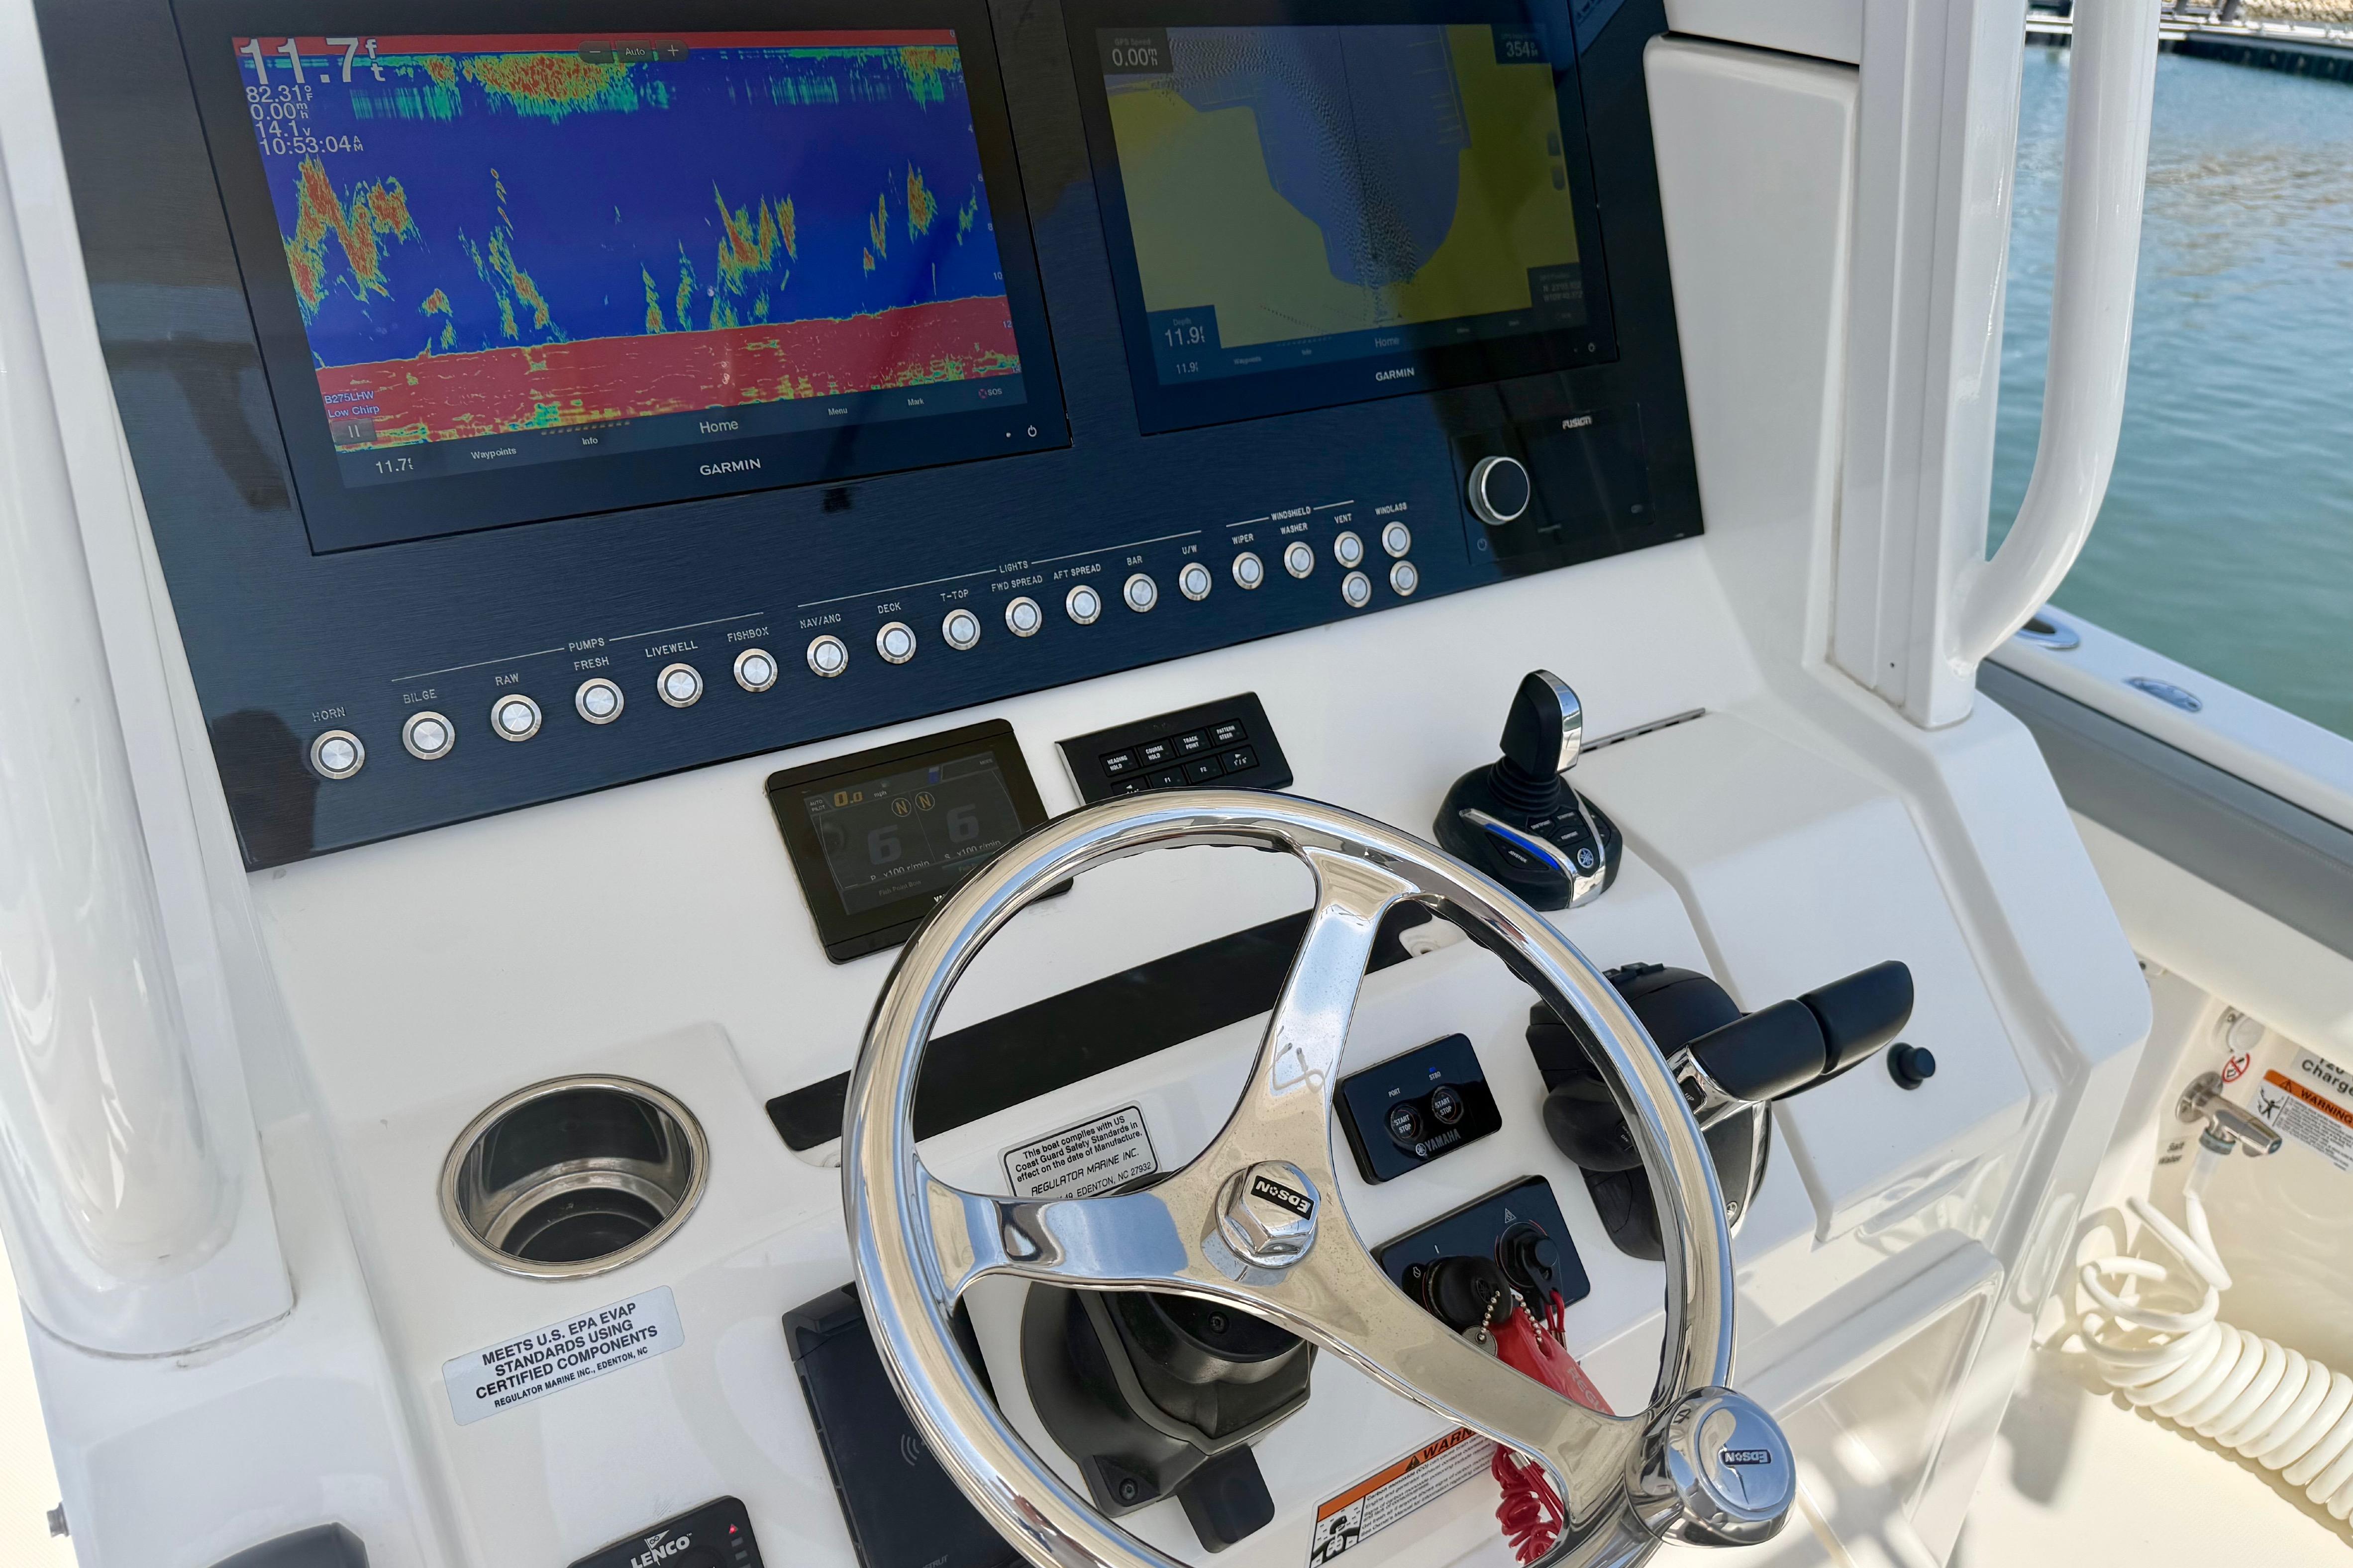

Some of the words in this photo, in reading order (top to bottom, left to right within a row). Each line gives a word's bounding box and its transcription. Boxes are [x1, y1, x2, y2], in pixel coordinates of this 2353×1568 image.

[625, 47, 645, 56] Auto
[1506, 41, 1530, 58] 354
[240, 37, 359, 85] 11.7
[1112, 48, 1148, 67] 0.00
[959, 75, 964, 83] 2
[246, 85, 302, 102] 82.31
[250, 102, 296, 120] 0.00
[255, 120, 299, 138] 14.1
[968, 124, 973, 133] 4
[260, 135, 351, 155] 10:53:04
[994, 272, 1003, 280] 10
[1003, 320, 1012, 328] 12
[1165, 326, 1200, 347] 11.9
[1375, 337, 1400, 348] Home
[1176, 362, 1195, 374] 11.9
[1375, 367, 1414, 382] GARMIN
[324, 390, 375, 405] B275LHW
[987, 388, 1003, 396] SOS
[908, 397, 924, 406] Mark
[327, 407, 349, 418] Low
[352, 404, 381, 418] Chirp
[828, 406, 848, 416] Menu
[700, 418, 738, 434] Home
[582, 436, 598, 446] Info
[471, 446, 517, 460] Waypoints
[375, 458, 407, 475] 11.7
[700, 458, 761, 476] GARMIN
[1271, 506, 1312, 521] WINDSHIELD
[1375, 502, 1408, 516] WINDLASS
[1334, 513, 1352, 524] VENT
[1280, 522, 1308, 535] WASHER
[1231, 533, 1254, 545] WIPER
[1182, 544, 1198, 555] U/W
[999, 561, 1028, 574] LIGHTS
[1126, 555, 1143, 566] BAR
[1053, 570, 1069, 581] AFT
[1071, 563, 1102, 577] SPREAD
[991, 582, 1009, 593] FWD
[1011, 575, 1043, 589] SPREAD
[940, 589, 969, 602] T-TOP
[877, 602, 902, 614] DECK
[800, 613, 841, 629] NAV/ANC
[727, 626, 769, 643] FISHBOX
[568, 637, 605, 652] PUMPS
[645, 640, 699, 658] LIVEWELL
[573, 656, 610, 672] FRESH
[495, 673, 519, 686] RAW
[403, 689, 437, 704] BILGE
[312, 706, 346, 722] HORN
[1216, 725, 1236, 735] PATTERN
[1183, 735, 1199, 744] TRACK
[1145, 745, 1164, 755] COURSE
[1107, 755, 1128, 765] HEADING
[834, 791, 863, 807] 0.0
[874, 790, 887, 798] mph
[946, 803, 980, 843] 6
[867, 824, 902, 865] 6
[1388, 1087, 1401, 1097] PORT
[1434, 1097, 1450, 1108] START
[2301, 1087, 2353, 1125] WARNING
[1440, 1105, 1452, 1116] STOP
[1394, 1114, 1410, 1126] START
[1399, 1123, 1411, 1133] STOP
[1023, 1148, 1040, 1160] This
[1042, 1142, 1059, 1153] boat
[1061, 1128, 1095, 1147] complies
[1096, 1121, 1112, 1133] with
[1114, 1116, 1125, 1125] US
[1425, 1128, 1461, 1152] YAMAHA
[1016, 1160, 1038, 1173] Coast
[1040, 1150, 1064, 1164] Guard
[1066, 1141, 1089, 1157] Safety
[1091, 1125, 1128, 1144] Standards
[1130, 1121, 1138, 1130] in
[1017, 1170, 1039, 1182] effect
[1053, 1159, 1066, 1169] the
[1067, 1152, 1084, 1164] date
[1085, 1147, 1094, 1156] of
[1095, 1131, 1143, 1153] Manufacture.
[1032, 1169, 1084, 1197] REGULATOR
[1087, 1154, 1120, 1175] MARINE
[1123, 1148, 1139, 1161] INC.
[1077, 1177, 1116, 1197] EDENTON,
[1118, 1170, 1129, 1181] NC
[1130, 1162, 1152, 1176] 27932
[1256, 1180, 1311, 1213] EDSON
[482, 1339, 533, 1366] MEETS
[537, 1329, 566, 1346] U.S.
[568, 1317, 598, 1335] EPA
[600, 1302, 636, 1324] EVAP
[495, 1338, 586, 1377] STANDARDS
[588, 1319, 633, 1343] USING
[476, 1362, 553, 1399] CERTIFIED
[557, 1325, 658, 1370] COMPONENTS
[494, 1384, 543, 1408] REGULATOR
[545, 1373, 576, 1390] MARINE
[576, 1367, 596, 1380] INC.,
[597, 1353, 636, 1371] EDENTON,
[637, 1346, 648, 1359] NC
[1422, 1428, 1476, 1461] WARN
[1725, 1451, 1768, 1463] EDSON
[1366, 1486, 1387, 1501] Carbon
[630, 1536, 690, 1568] LENCO
